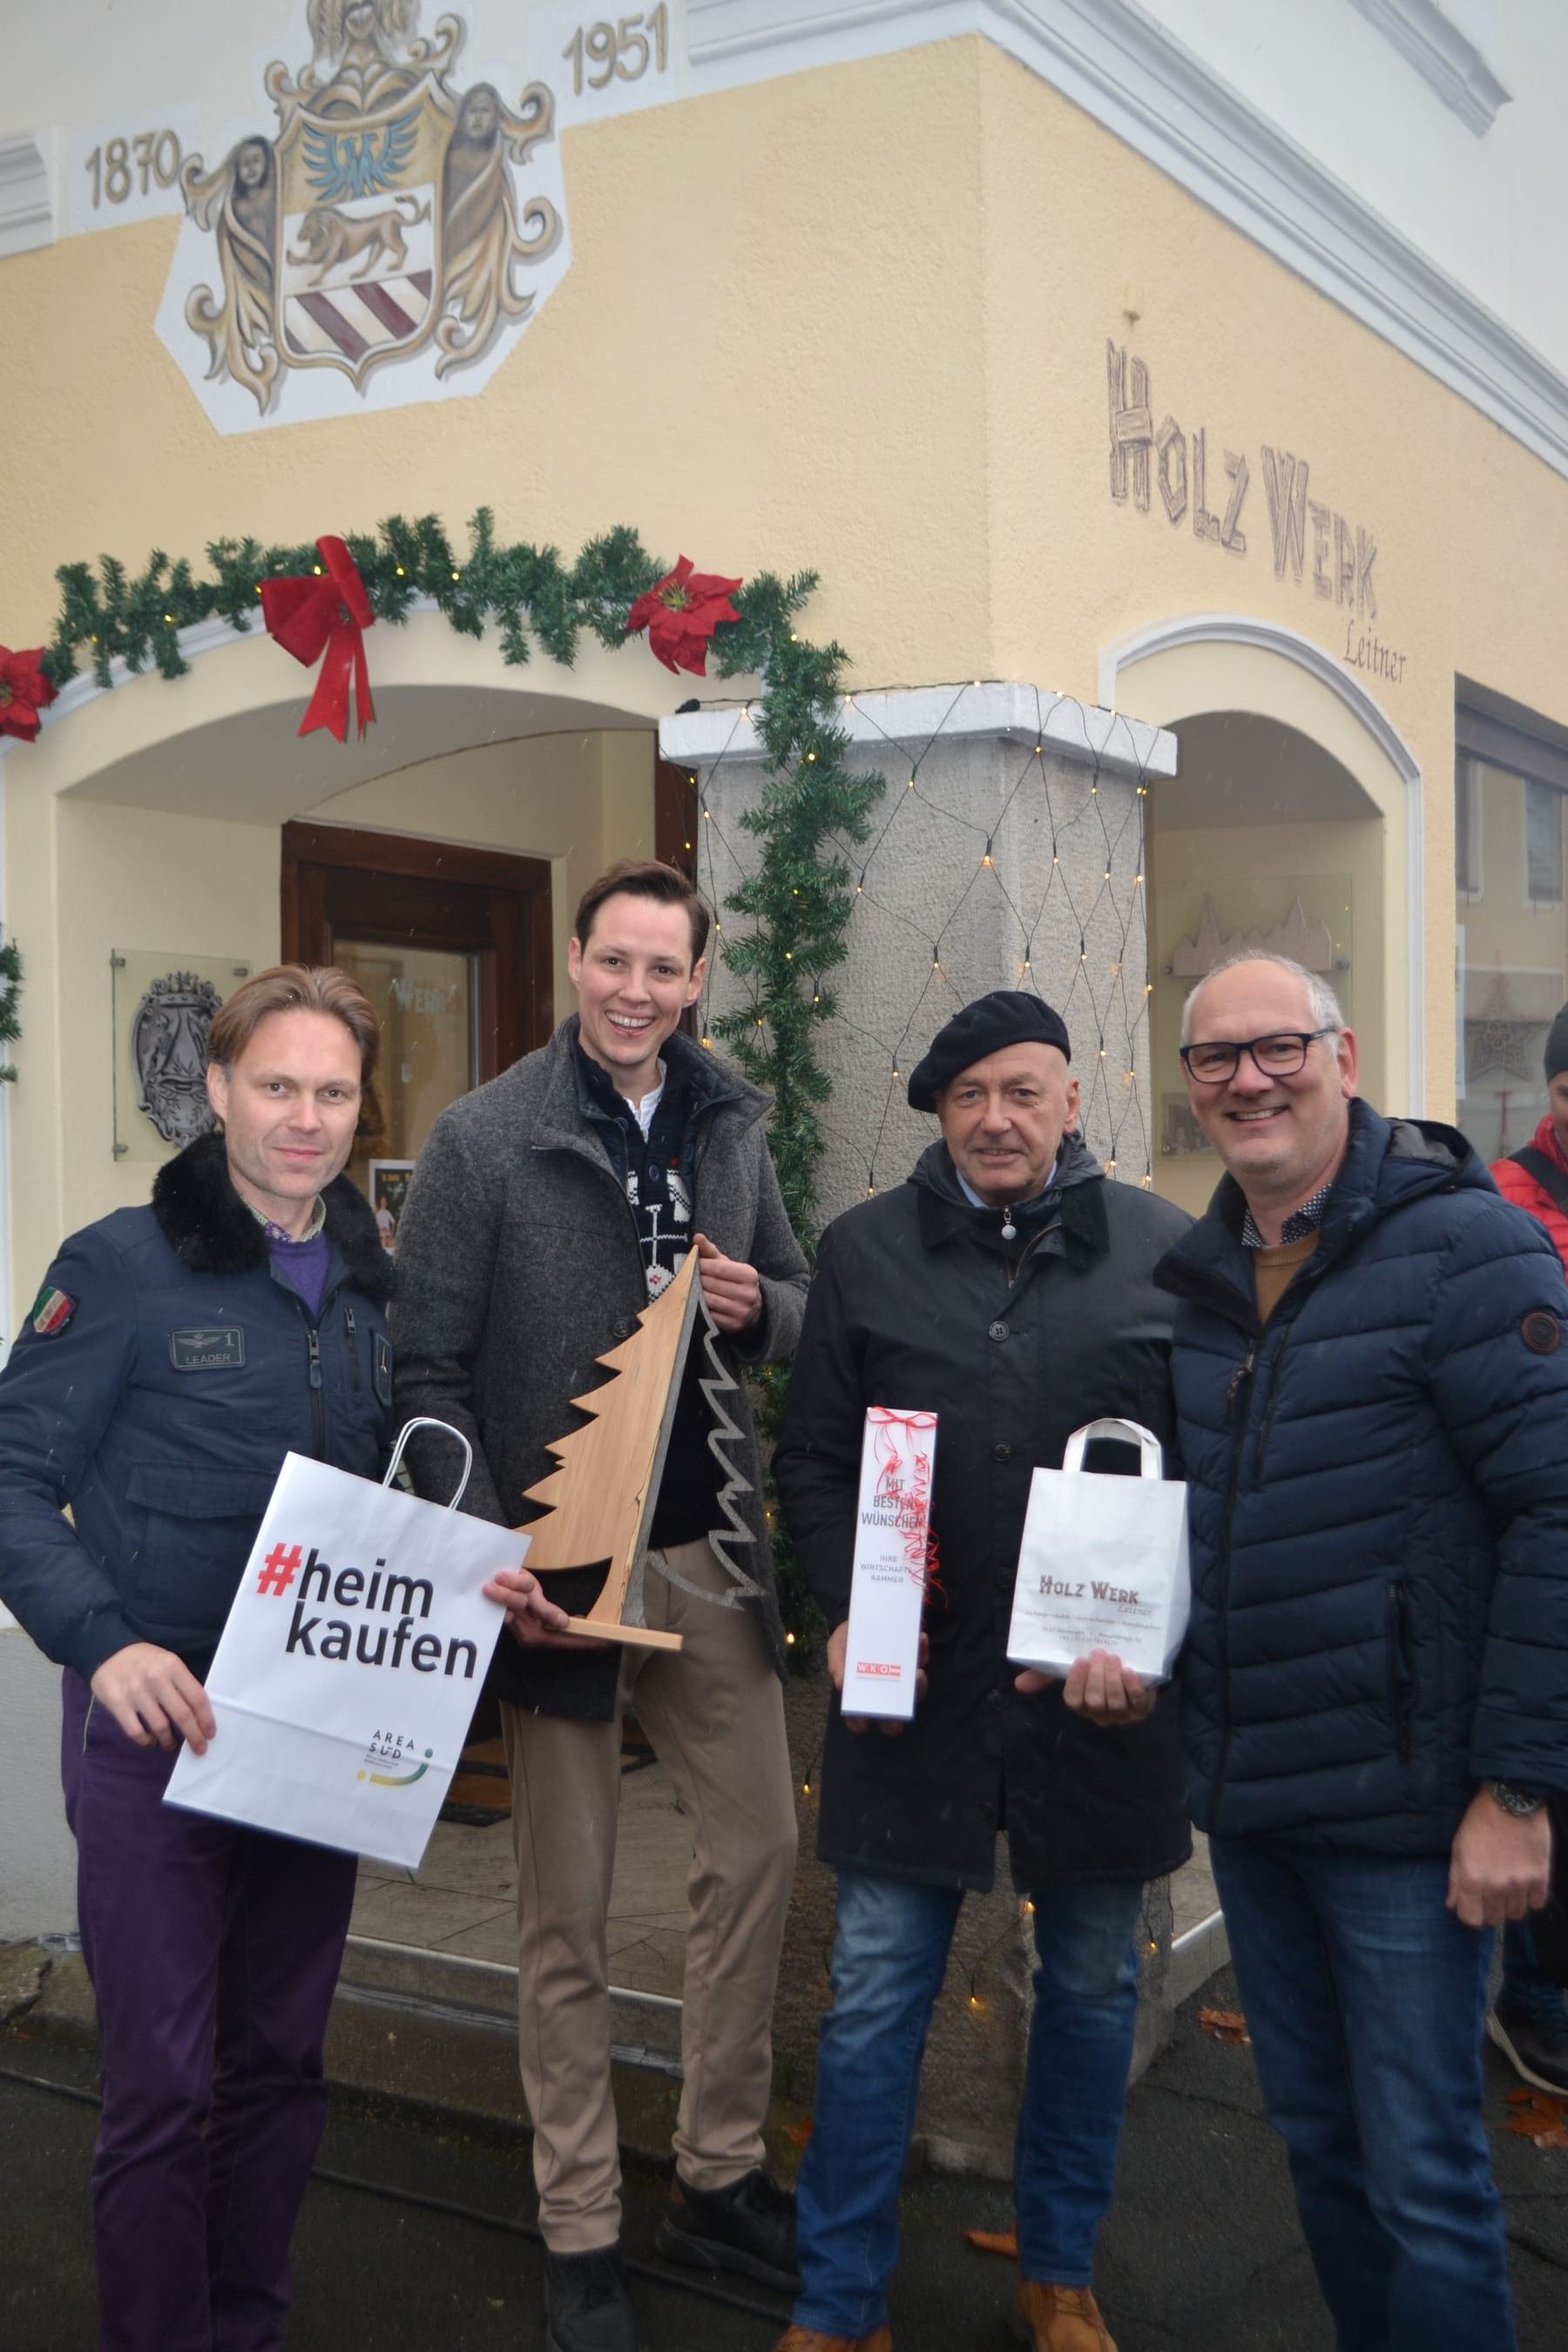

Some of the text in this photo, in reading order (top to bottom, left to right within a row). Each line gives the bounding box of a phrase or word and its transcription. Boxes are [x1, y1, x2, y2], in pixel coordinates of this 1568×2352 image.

[84, 3, 669, 209] 1870 1951
[1106, 337, 1378, 619] HOLZ WERK
[1342, 618, 1407, 683] Leitner
[186, 1353, 231, 1364] LEADER
[256, 1542, 434, 1619] #heim
[1039, 1574, 1139, 1604] HOLZ WERK
[285, 1599, 478, 1679] kaufen
[857, 1662, 889, 1675] WKO
[372, 1729, 416, 1750] AREA
